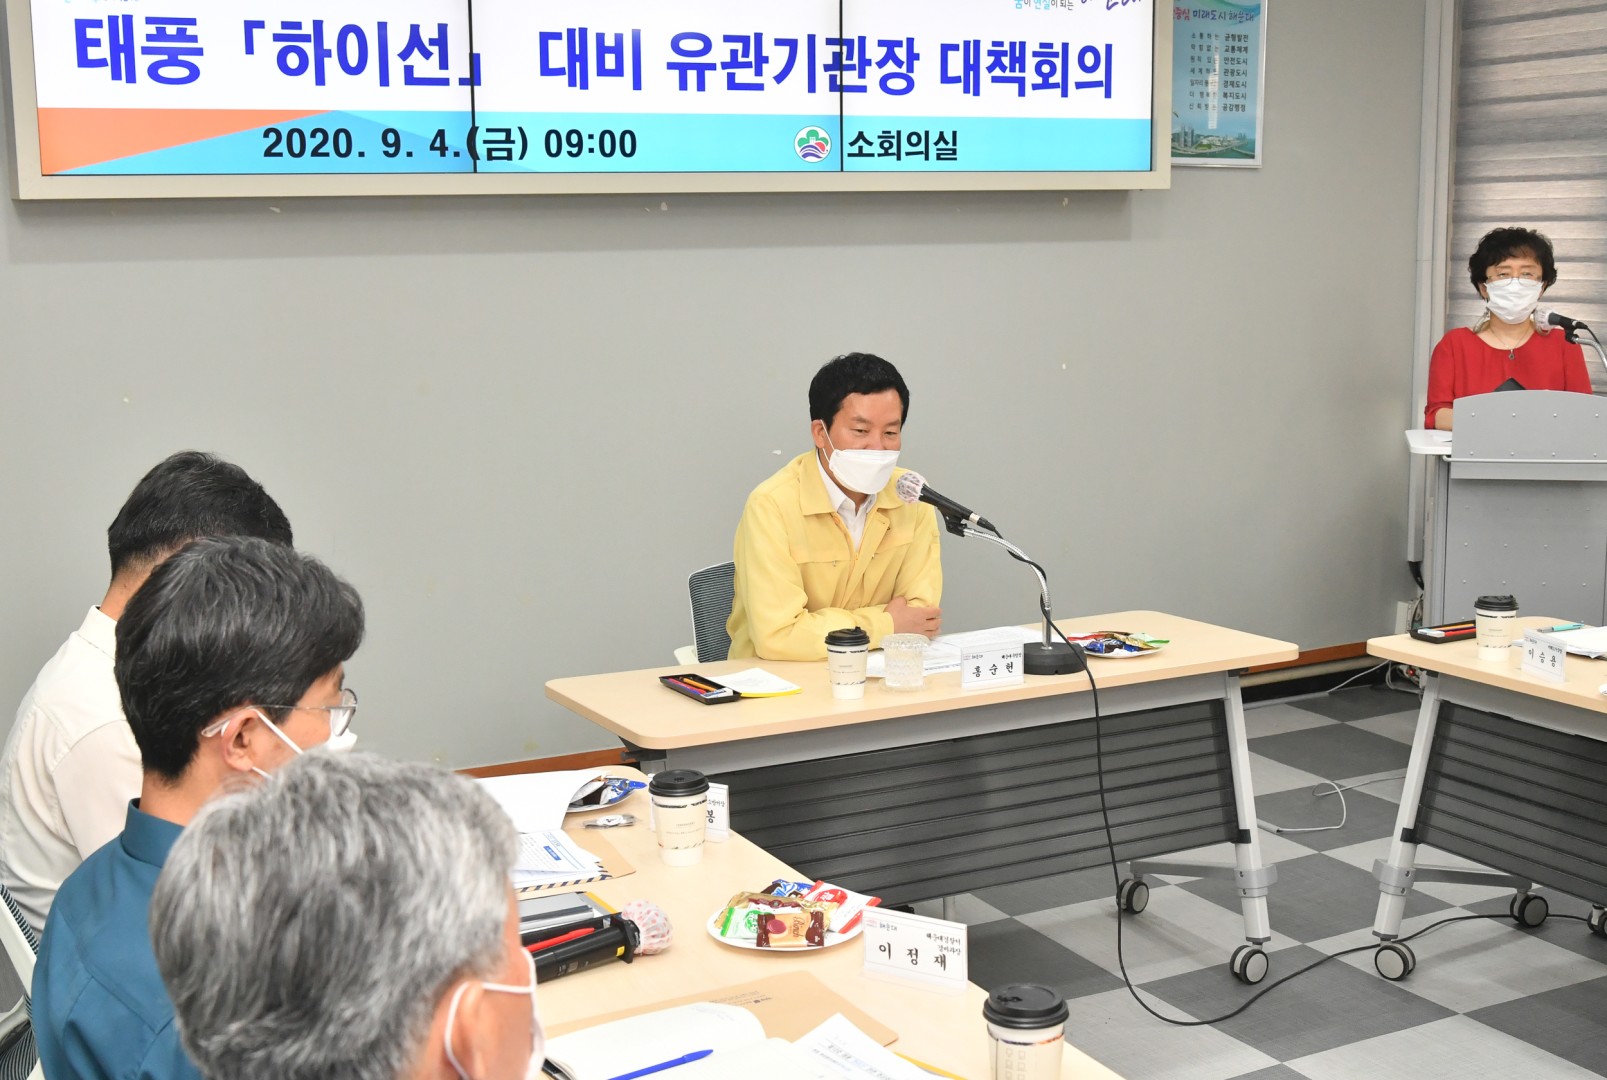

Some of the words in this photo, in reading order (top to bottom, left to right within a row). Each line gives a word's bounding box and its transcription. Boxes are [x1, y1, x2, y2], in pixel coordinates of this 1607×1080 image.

[1174, 7, 1190, 21] 중심
[1192, 8, 1227, 21] 미래도시
[74, 14, 205, 86] 태풍
[538, 27, 643, 91] 대비
[666, 31, 920, 97] 유관기관장
[940, 39, 1114, 99] 대책회의
[1223, 56, 1248, 66] 안전도시
[1223, 68, 1248, 77] 관광도시
[1223, 80, 1247, 89] 경제도시
[1222, 92, 1247, 100] 복지도시
[1222, 103, 1247, 112] 공감행정
[262, 127, 364, 158] 2020.
[381, 128, 414, 158] 9.
[429, 126, 529, 161] 4.(금)
[543, 129, 637, 158] 09:00
[846, 129, 959, 162] 소회의실
